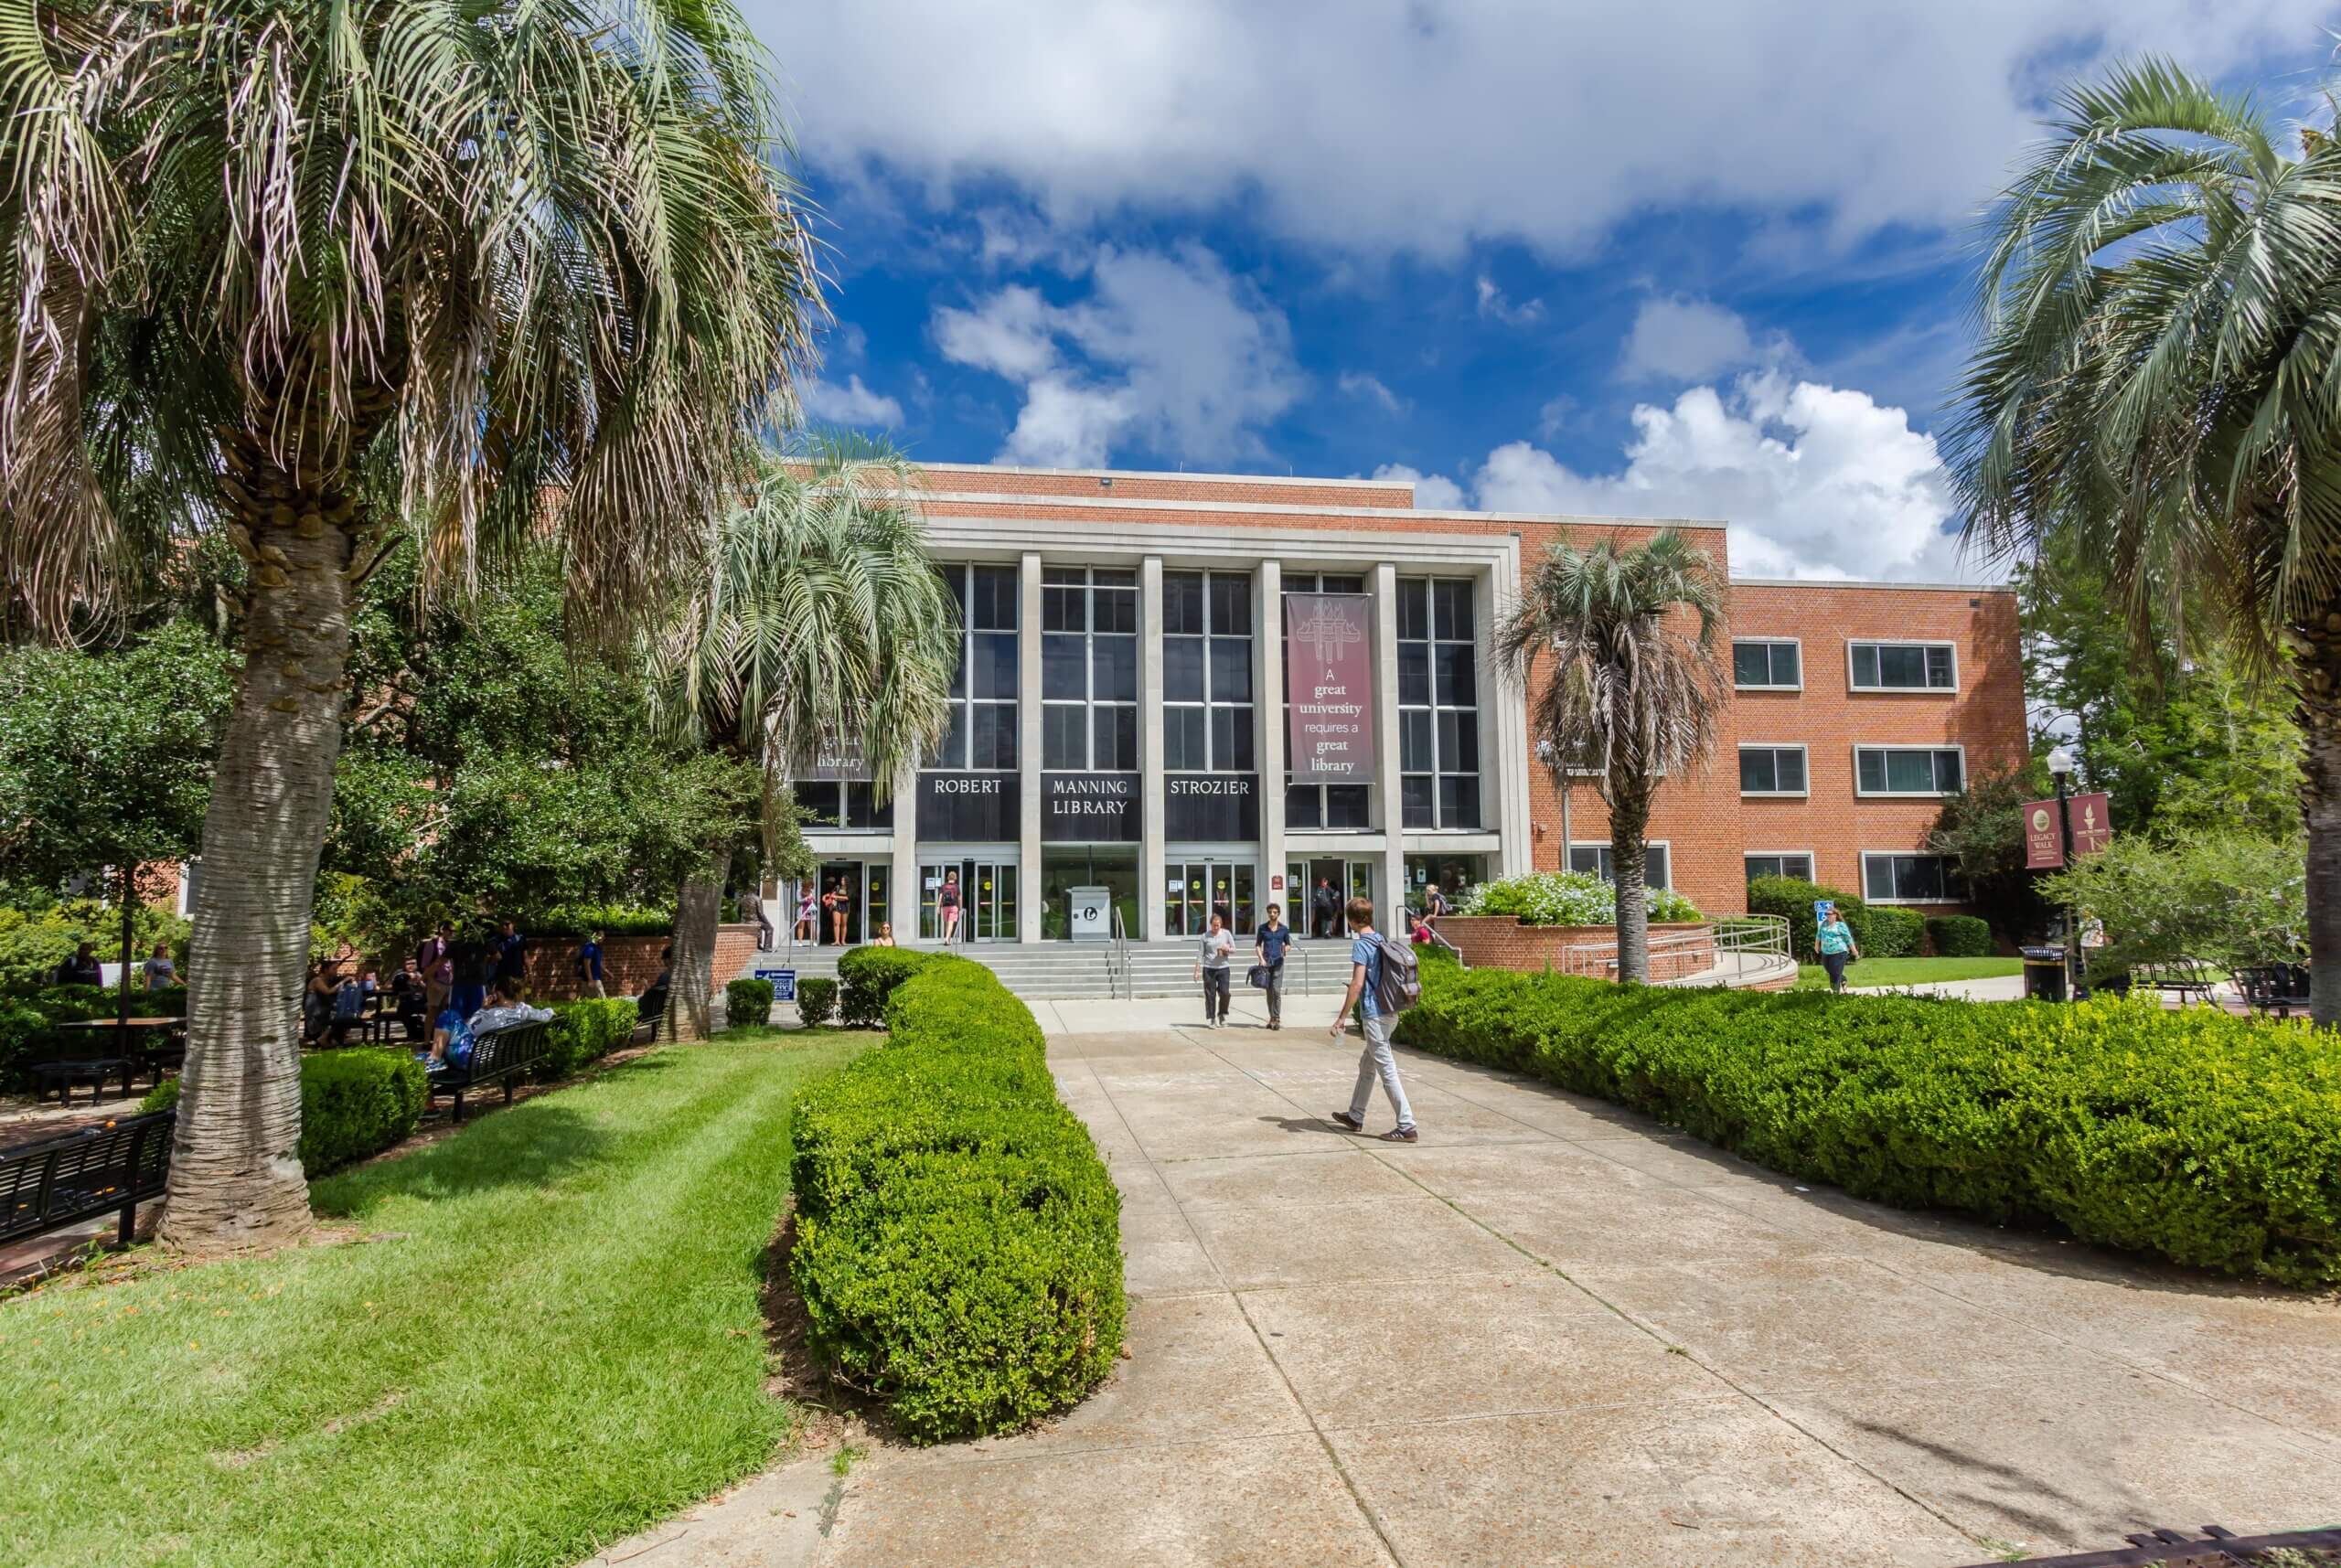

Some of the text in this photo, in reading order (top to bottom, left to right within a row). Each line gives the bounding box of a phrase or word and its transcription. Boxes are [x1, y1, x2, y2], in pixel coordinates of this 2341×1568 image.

[1325, 668, 1335, 681] A
[1314, 684, 1346, 699] great
[1299, 701, 1363, 718] university
[1305, 722, 1358, 735] requires a
[1316, 740, 1349, 755] great
[1310, 758, 1354, 774] library
[935, 779, 1002, 794] ROBERT
[1053, 780, 1128, 794] MANNING
[1170, 781, 1249, 795] STROZIER
[1053, 801, 1128, 815] LIBRARY
[2030, 832, 2056, 842] LEGACY
